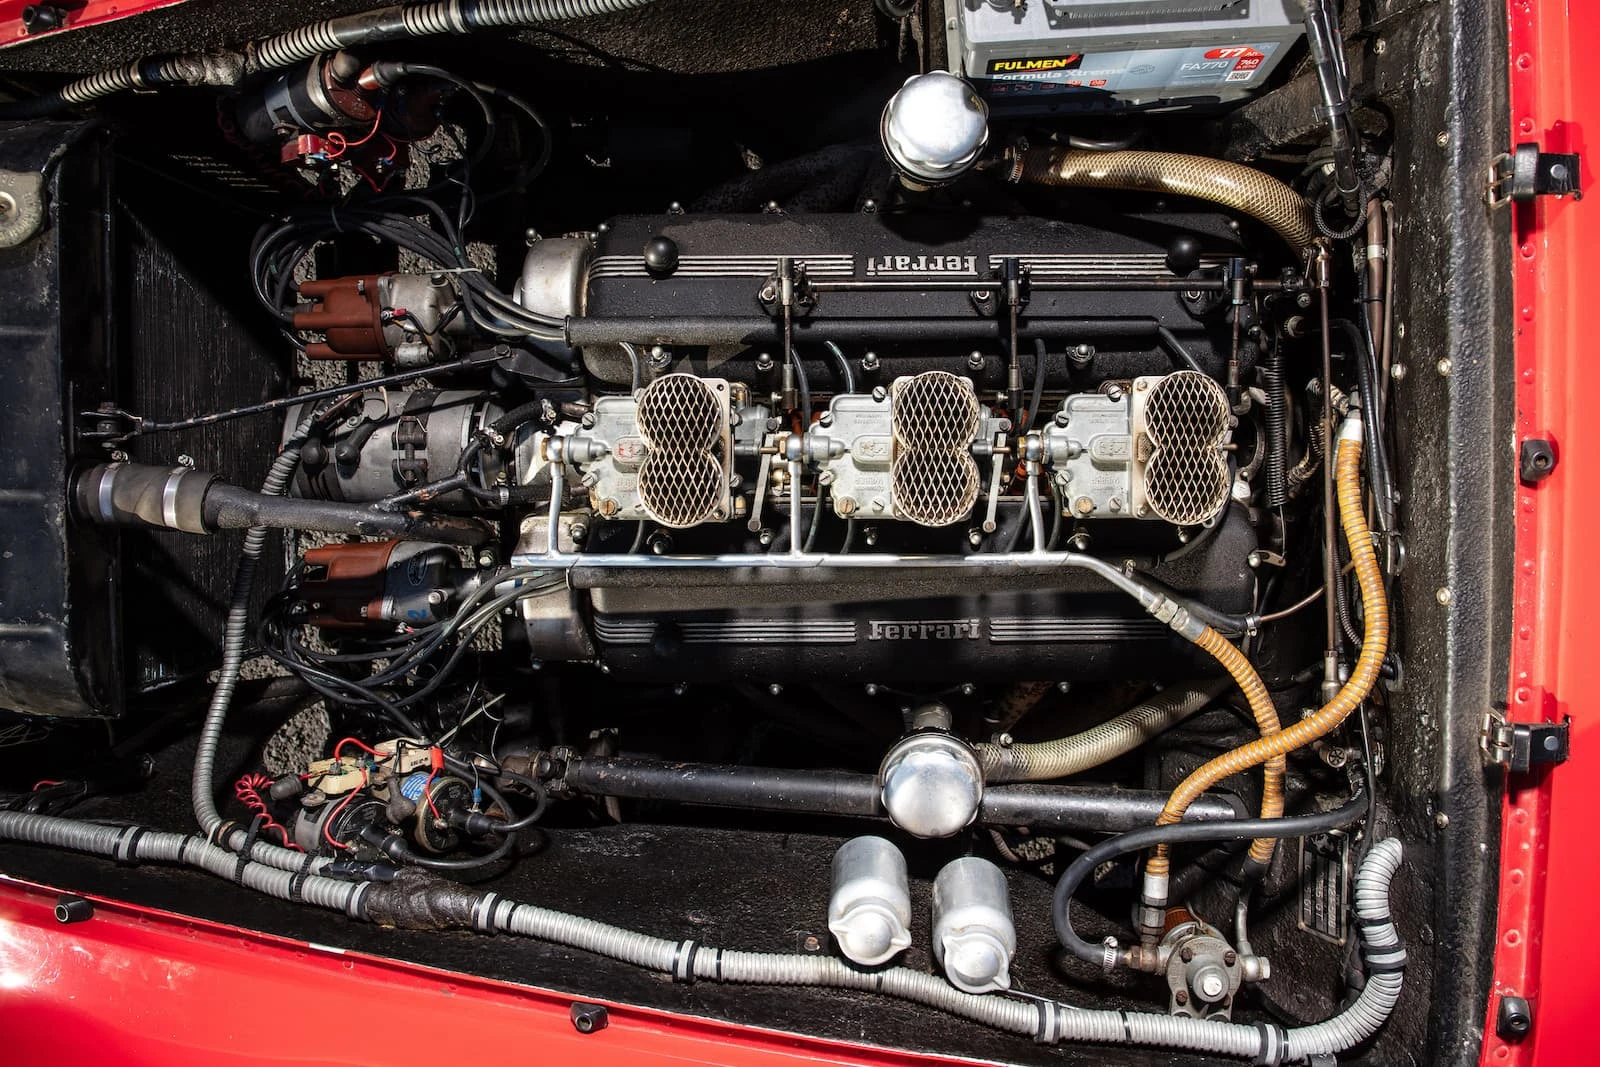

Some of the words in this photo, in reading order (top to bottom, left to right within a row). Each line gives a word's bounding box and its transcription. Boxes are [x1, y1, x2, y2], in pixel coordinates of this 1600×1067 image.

[1219, 47, 1248, 58] 77
[994, 60, 1067, 71] FULMEN
[1180, 61, 1229, 71] FA770
[992, 71, 1063, 81] Formula
[867, 255, 978, 276] Ferrari
[868, 618, 980, 640] Ferrari
